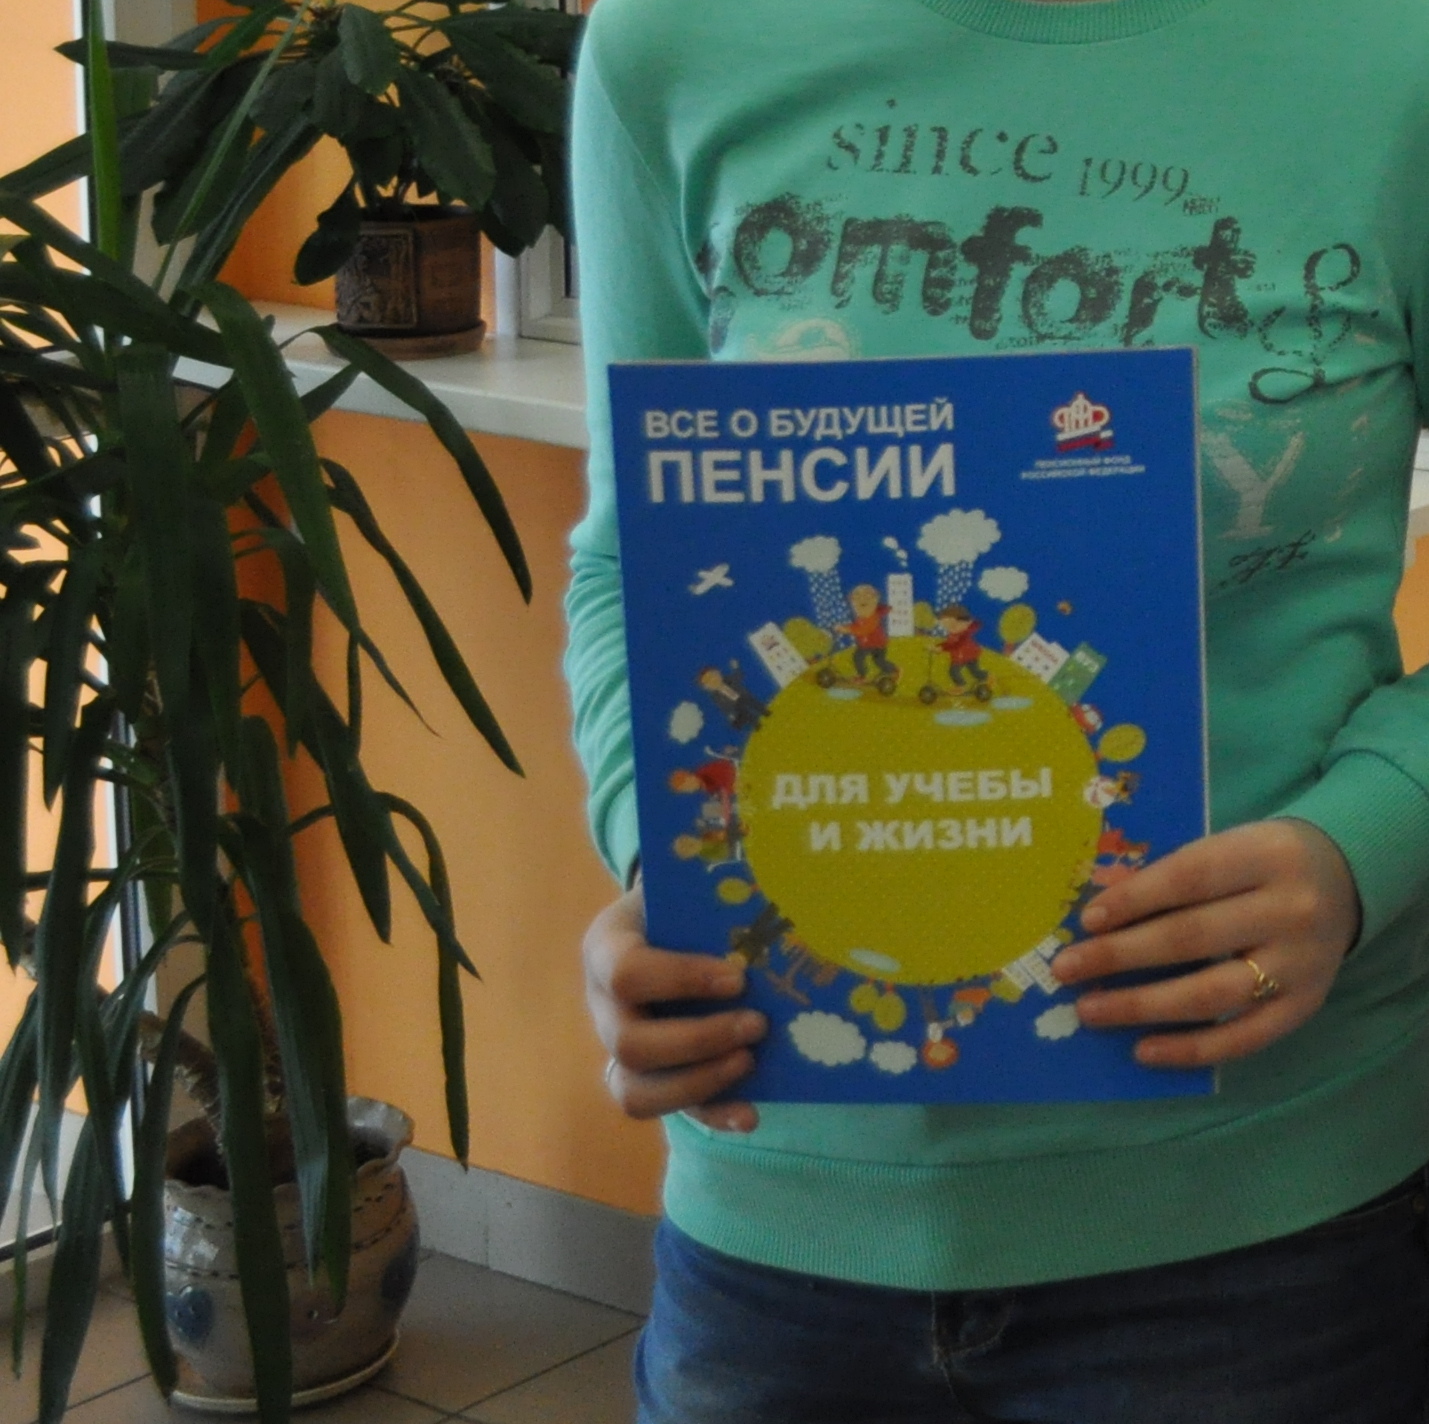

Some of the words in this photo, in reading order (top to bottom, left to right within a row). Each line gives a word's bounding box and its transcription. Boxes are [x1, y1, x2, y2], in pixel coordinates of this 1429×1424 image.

[827, 98, 1060, 183] since
[1077, 154, 1188, 207] 1999
[644, 408, 719, 438] ВСЕ
[730, 409, 759, 437] О
[769, 397, 955, 441] БУДУЩЕЙ
[647, 442, 957, 503] ПЕНСИИ
[771, 771, 870, 810] ДЛЯ
[885, 766, 1053, 803] УЧЕБЫ
[809, 821, 842, 852] И
[856, 815, 1034, 852] ЖИЗНИ
